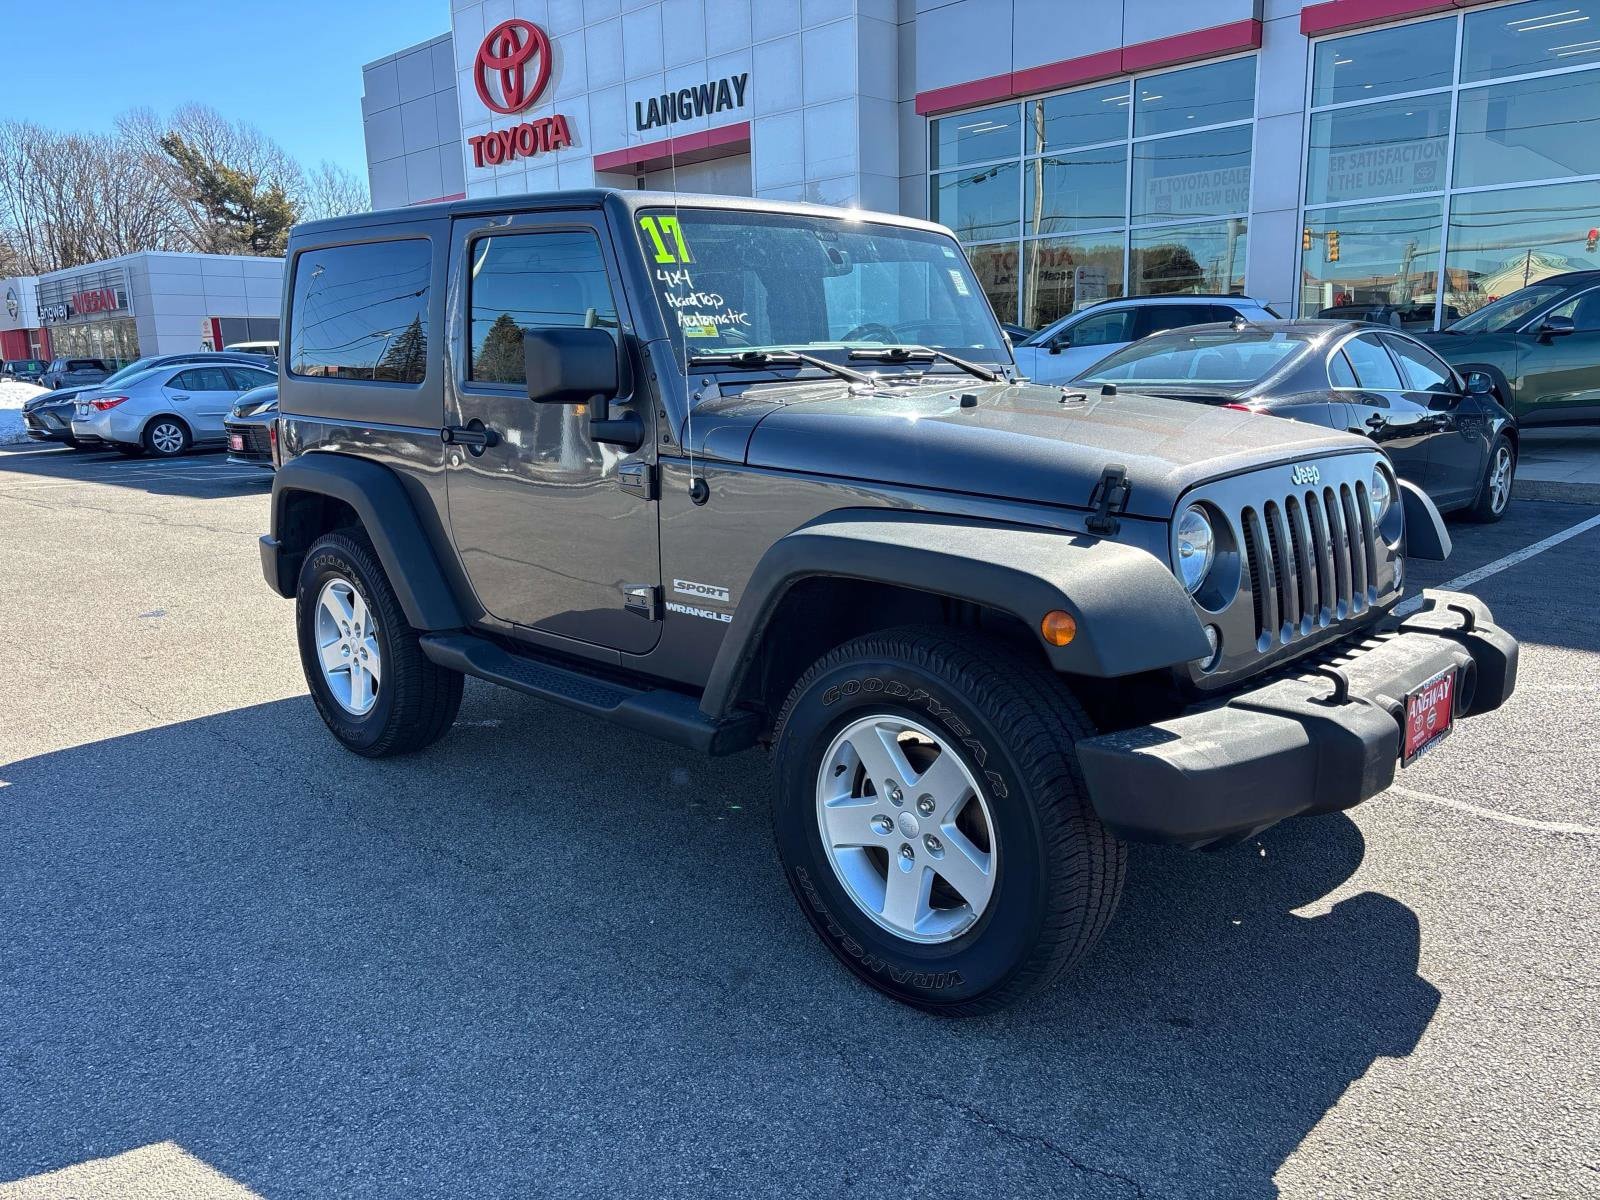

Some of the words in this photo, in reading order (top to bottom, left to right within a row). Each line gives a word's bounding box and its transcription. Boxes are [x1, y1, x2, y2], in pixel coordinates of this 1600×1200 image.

[634, 73, 748, 131] LANGWAY
[468, 114, 572, 168] TOYOTA
[1350, 141, 1447, 169] SATISFACTION
[1167, 173, 1210, 193] TOYOTA
[1338, 172, 1363, 190] THE
[1180, 193, 1194, 209] IN
[1195, 190, 1221, 206] NEW
[640, 216, 691, 264] 17
[38, 304, 69, 322] Langway
[72, 287, 118, 315] NISSAN
[677, 308, 752, 327] Automatic
[1291, 465, 1320, 486] Jeep
[675, 580, 728, 599] SPORT
[665, 602, 733, 623] WRANGLE
[1409, 677, 1450, 721] ANGWAY
[822, 677, 1008, 799] GOODYEAR
